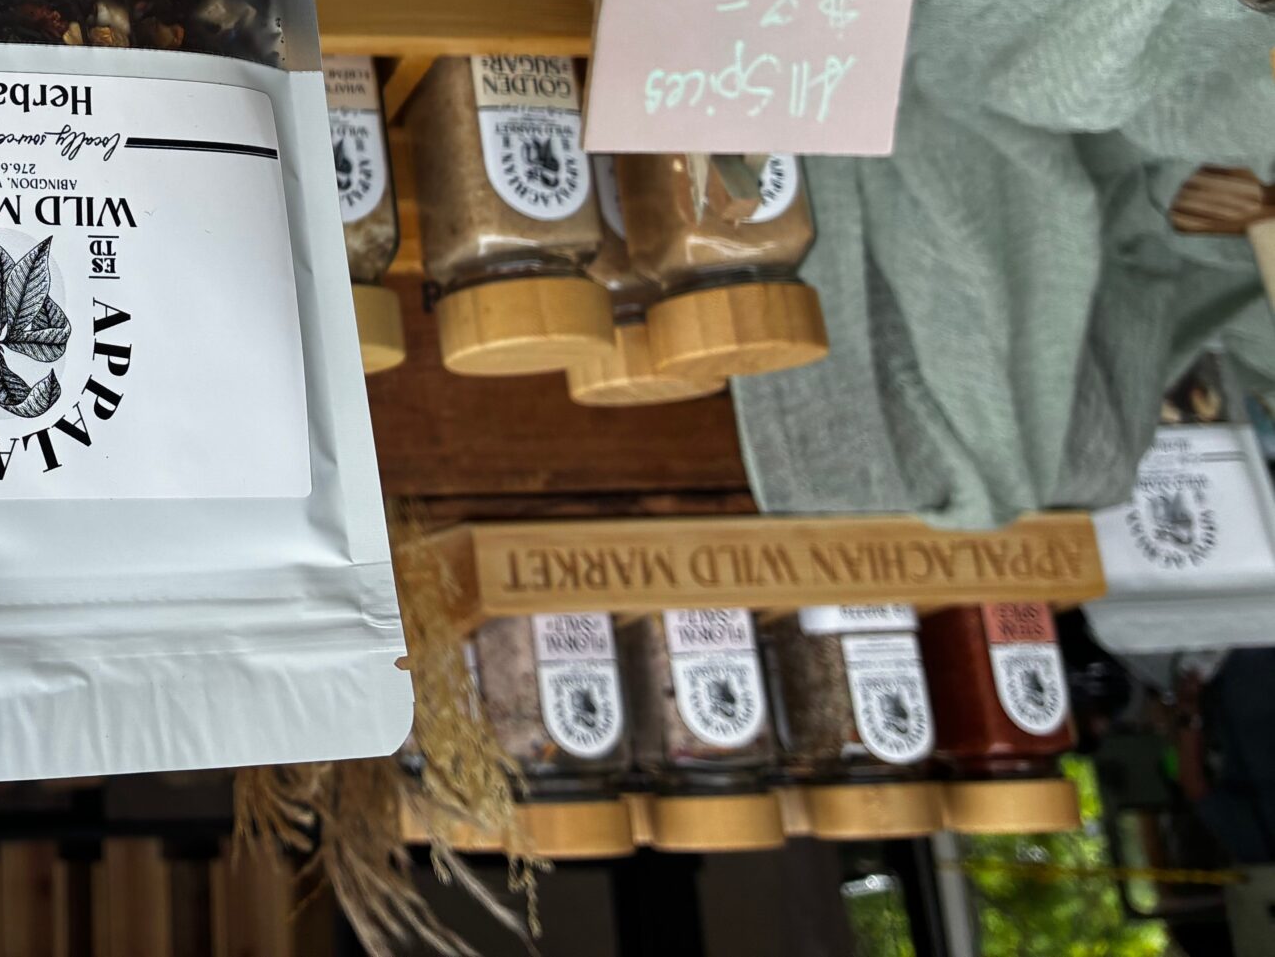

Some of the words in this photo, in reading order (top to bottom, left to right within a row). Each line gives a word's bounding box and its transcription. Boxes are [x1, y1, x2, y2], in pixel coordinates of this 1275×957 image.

[489, 53, 561, 76] SUGAR
[644, 39, 781, 116] Spices
[483, 74, 571, 100] GOLDEN
[788, 55, 857, 123] All
[44, 124, 121, 162] locally
[34, 195, 138, 228] WILD
[501, 547, 680, 593] MARKET
[688, 545, 800, 589] WILD
[809, 540, 1081, 588] APPALACHIAN
